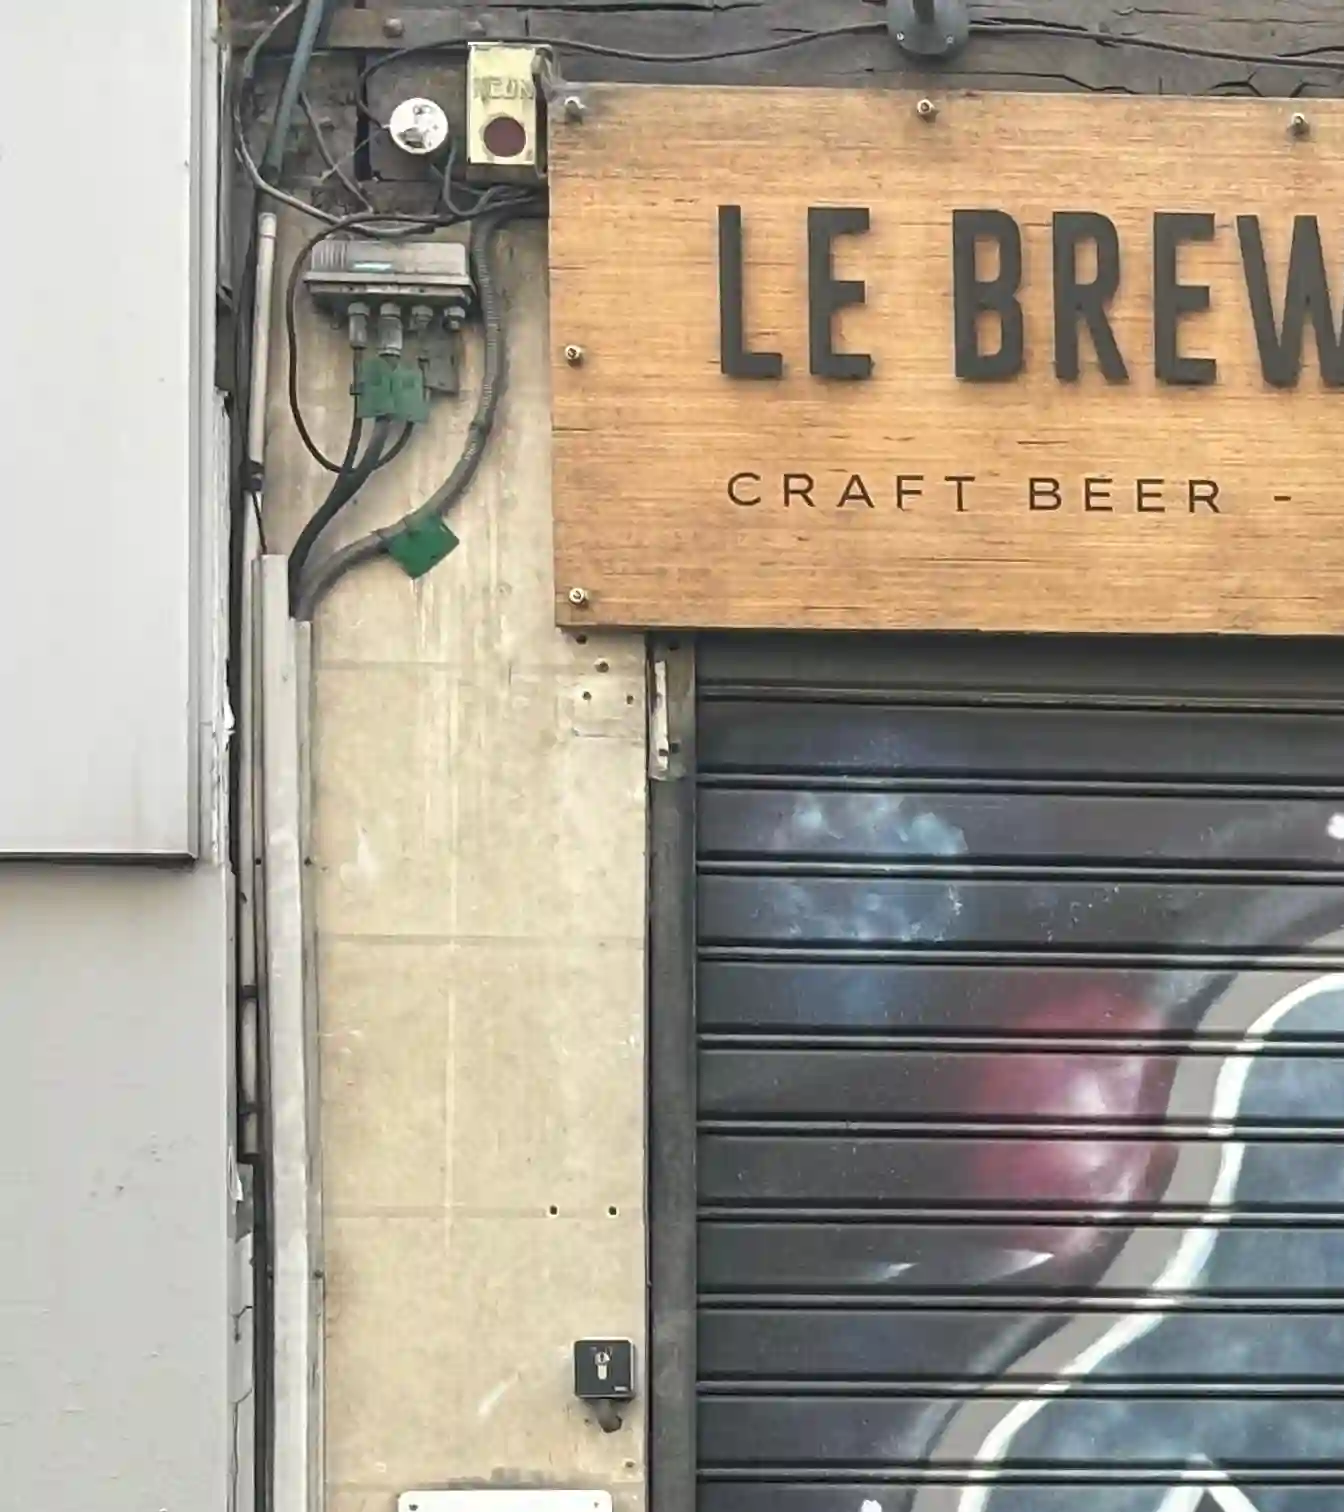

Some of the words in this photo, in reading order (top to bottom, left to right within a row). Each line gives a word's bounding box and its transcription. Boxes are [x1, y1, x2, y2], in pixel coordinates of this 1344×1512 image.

[718, 205, 875, 383] LE
[726, 472, 976, 512] CRAFT
[1029, 477, 1221, 513] BEER
